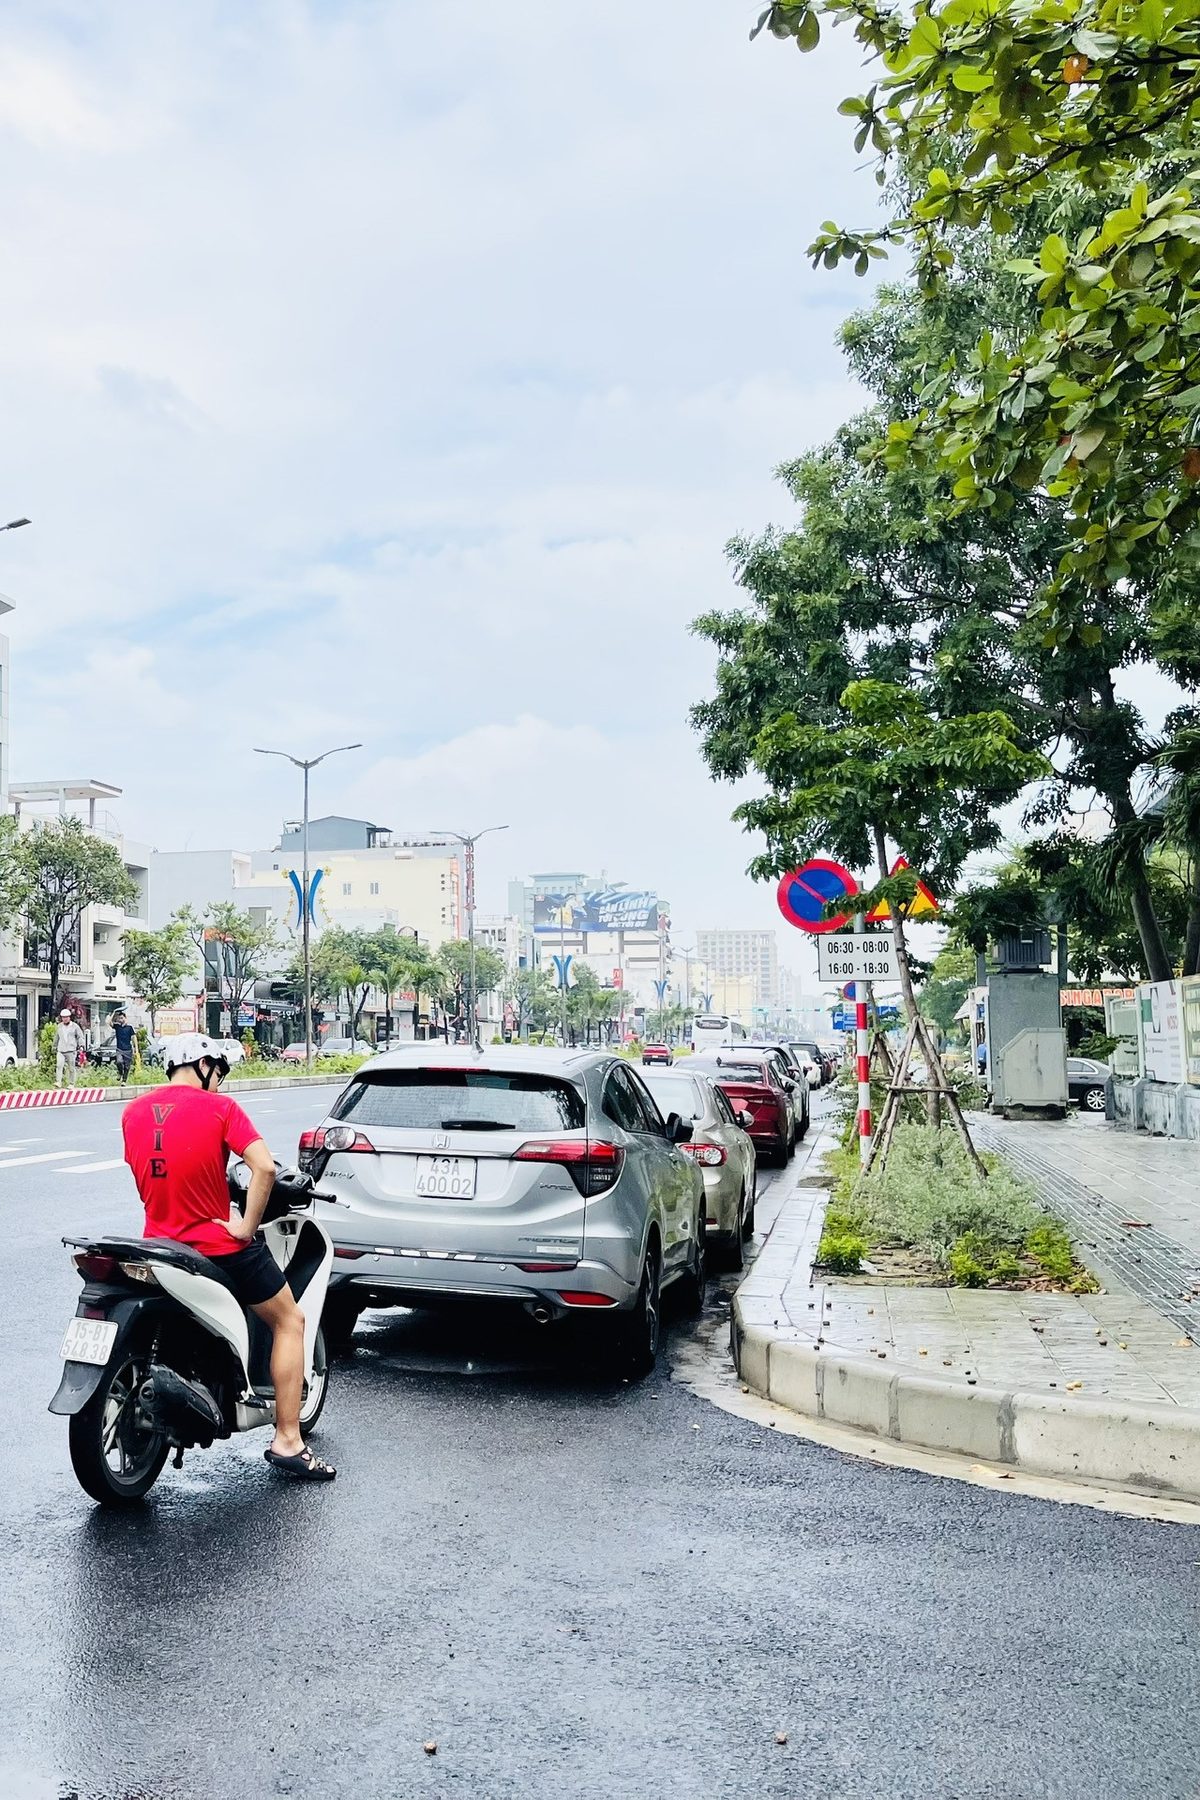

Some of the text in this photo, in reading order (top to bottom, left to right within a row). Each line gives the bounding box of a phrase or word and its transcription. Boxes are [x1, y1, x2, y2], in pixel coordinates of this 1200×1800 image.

[828, 942, 853, 953] 06:30
[862, 941, 889, 953] 08:00
[829, 963, 853, 974] 16:00
[863, 962, 889, 974] 18:30
[152, 1104, 175, 1178] VIE
[429, 1157, 461, 1176] 43A
[416, 1177, 471, 1196] 400.02
[74, 1322, 109, 1343] 15-B1
